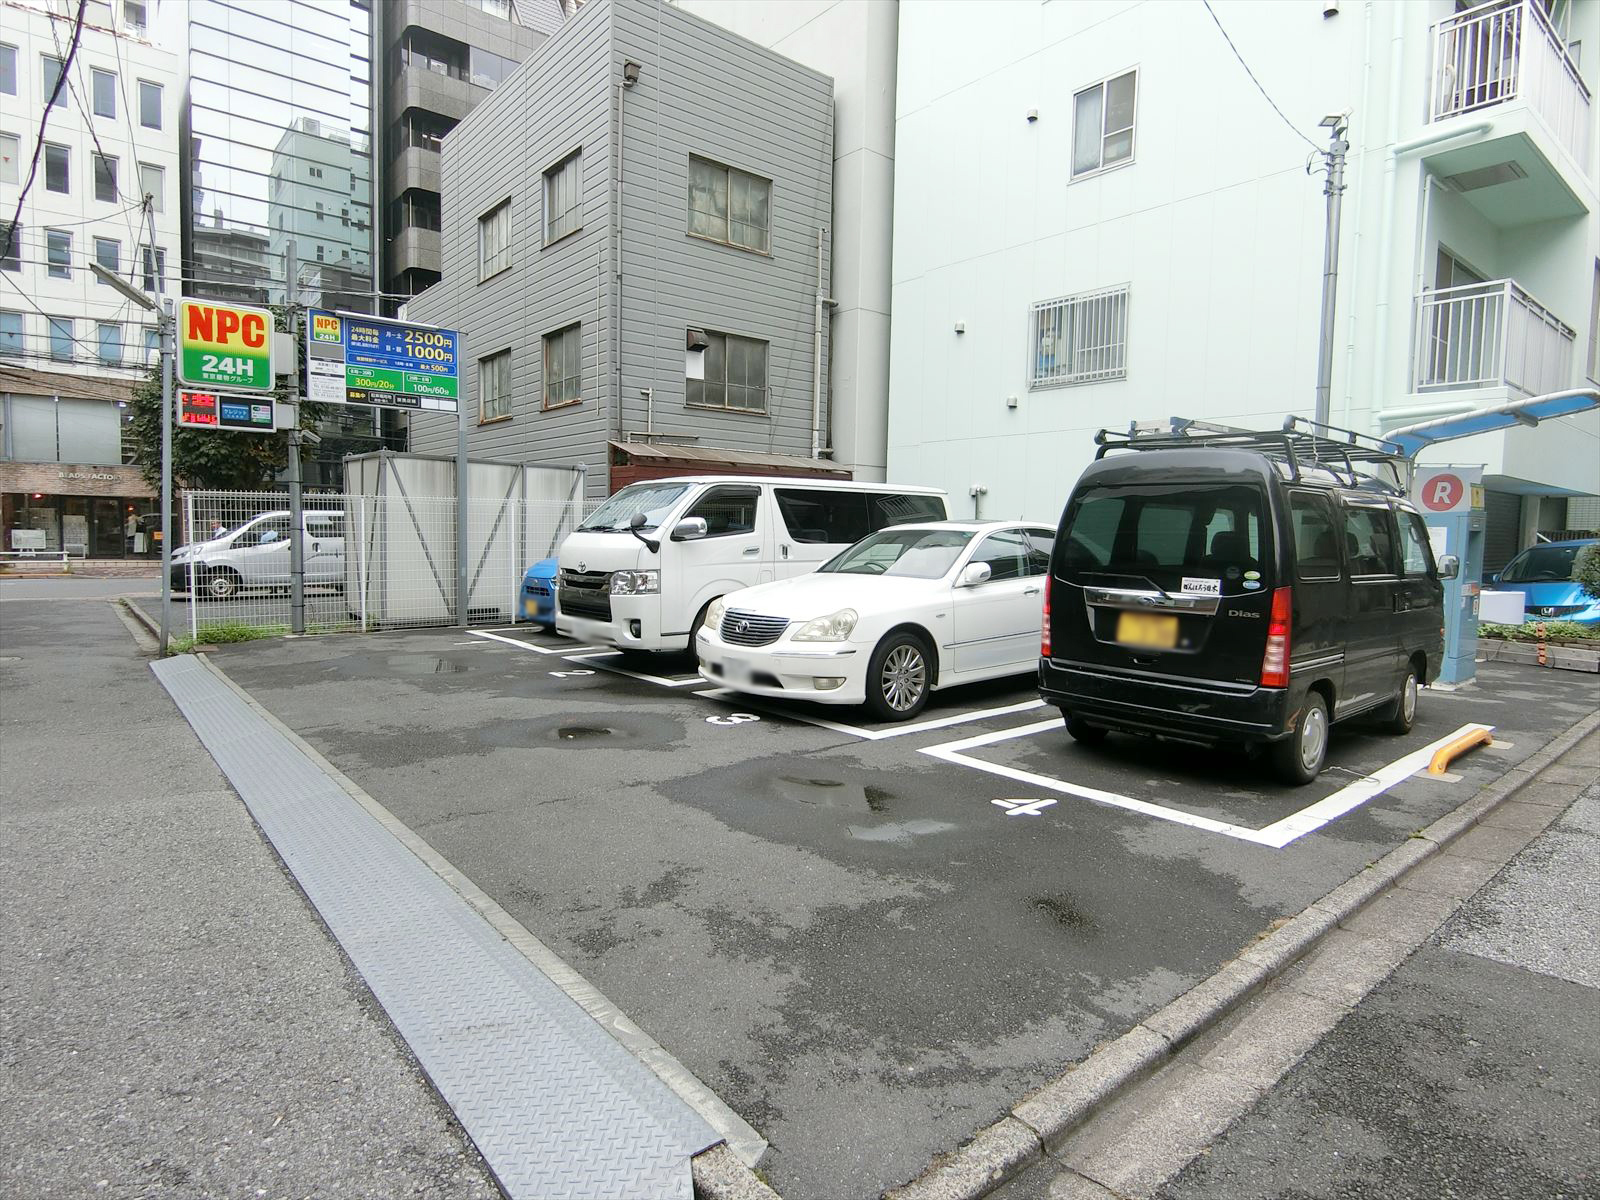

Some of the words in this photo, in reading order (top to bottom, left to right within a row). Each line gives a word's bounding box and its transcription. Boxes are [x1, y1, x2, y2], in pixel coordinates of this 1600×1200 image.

[188, 305, 265, 348] NPC
[316, 317, 338, 331] NPC
[319, 333, 336, 341] 24H
[351, 334, 380, 344] 最大料金
[404, 330, 453, 348] 2500円
[405, 344, 453, 362] 1000円
[202, 355, 254, 376] 24H
[1433, 481, 1452, 504] R
[1228, 609, 1261, 618] Dias
[549, 669, 596, 678] 2
[705, 712, 761, 726] 3
[990, 798, 1058, 816] 4
